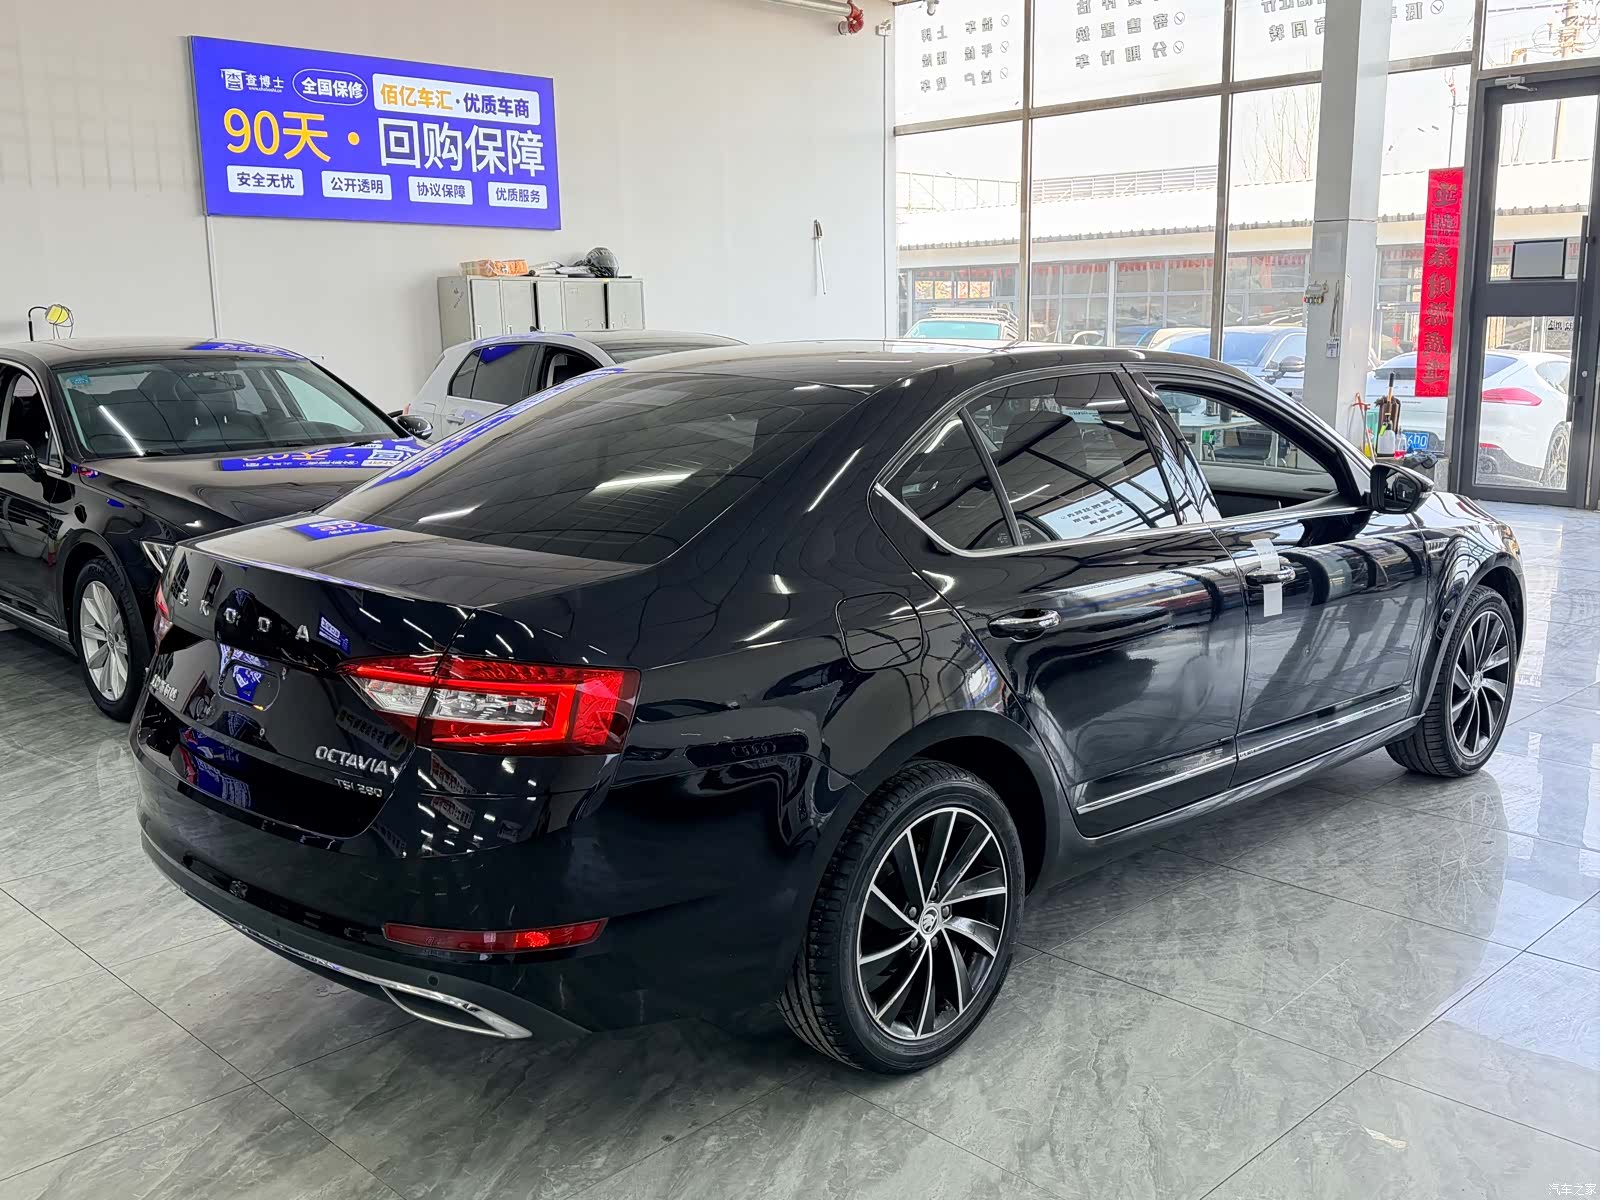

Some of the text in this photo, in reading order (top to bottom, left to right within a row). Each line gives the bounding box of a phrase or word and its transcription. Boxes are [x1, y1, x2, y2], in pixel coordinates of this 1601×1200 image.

[244, 72, 284, 90] 查博士
[301, 76, 364, 99] 全国保修
[236, 171, 295, 190] 安全无忧
[330, 175, 384, 195] 公开透明
[416, 182, 467, 199] 协议保障
[495, 187, 541, 204] 优质服务
[315, 745, 388, 776] OCTAVIA
